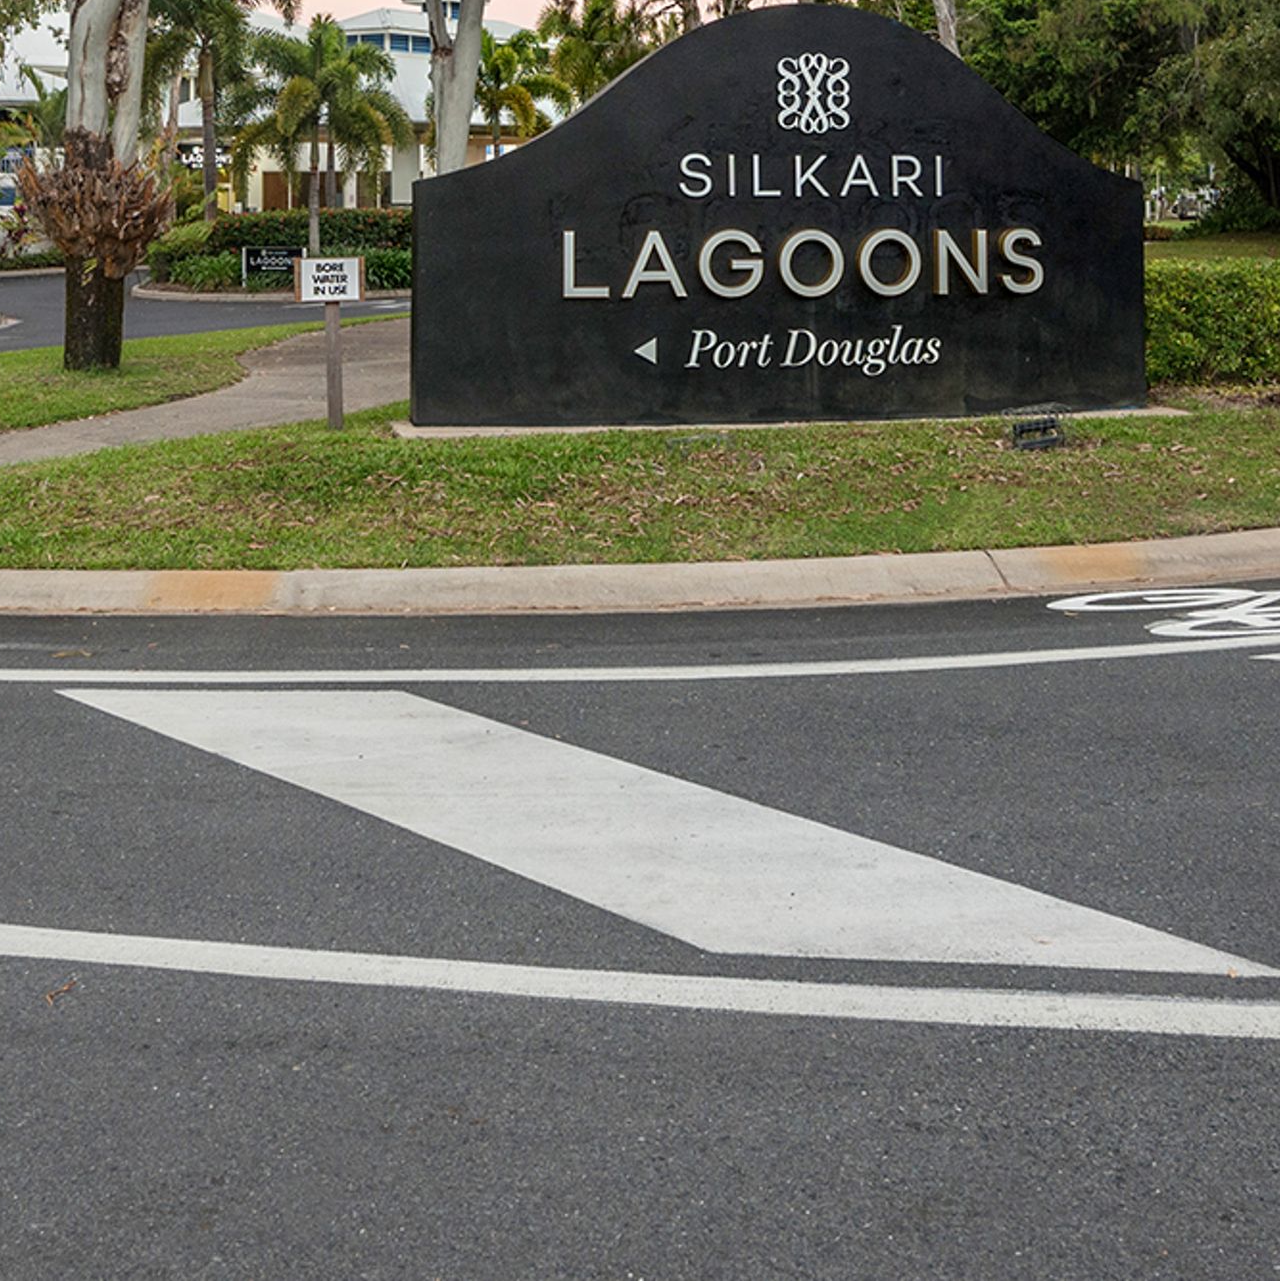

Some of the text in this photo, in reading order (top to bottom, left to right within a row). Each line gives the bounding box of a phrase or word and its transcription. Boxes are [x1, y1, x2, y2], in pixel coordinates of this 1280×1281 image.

[679, 152, 943, 198] SILKARI
[315, 262, 344, 273] BORE
[562, 228, 1044, 298] LAGOONS
[312, 274, 348, 284] WATER
[313, 285, 348, 295] IN USE
[684, 324, 942, 376] Port Douglas
